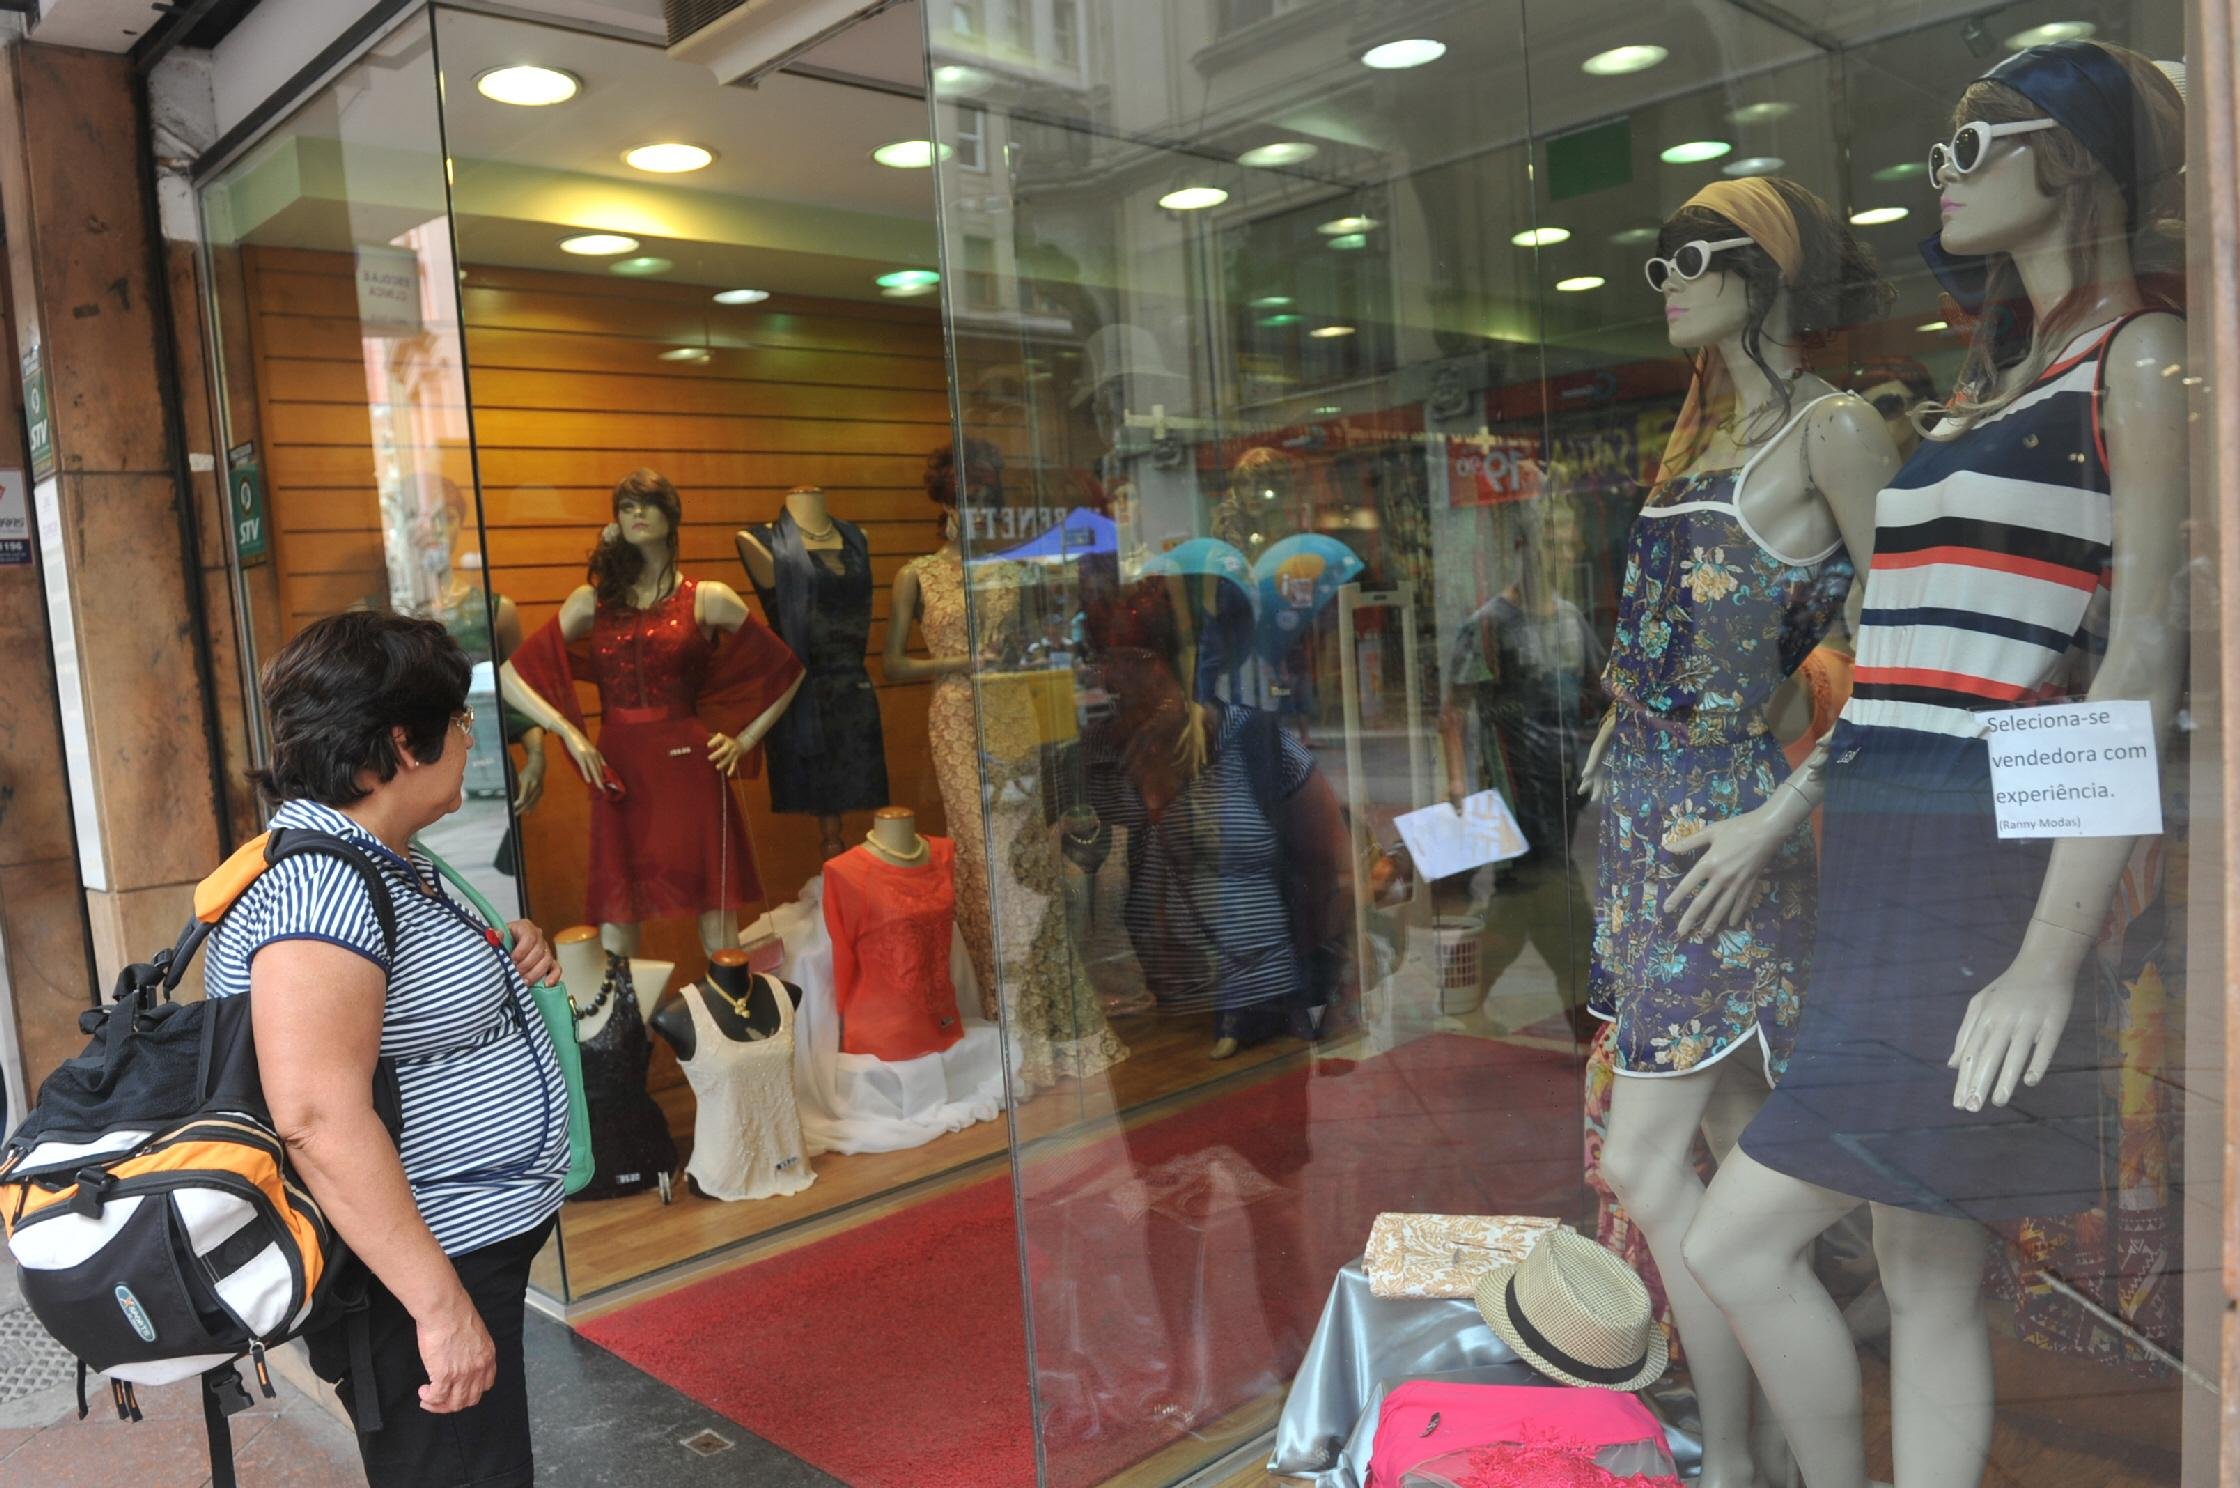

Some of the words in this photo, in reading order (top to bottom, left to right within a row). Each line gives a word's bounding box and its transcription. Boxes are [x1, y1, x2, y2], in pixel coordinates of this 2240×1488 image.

[30, 419, 47, 451] STV
[240, 517, 260, 546] STV
[1987, 709, 2111, 733] Seleciona-se
[1992, 747, 2097, 768] vendedora
[2103, 744, 2147, 761] com
[1996, 783, 2115, 806] experiência.
[1999, 818, 2036, 831] (Ranny
[2039, 816, 2081, 829] Modas)
